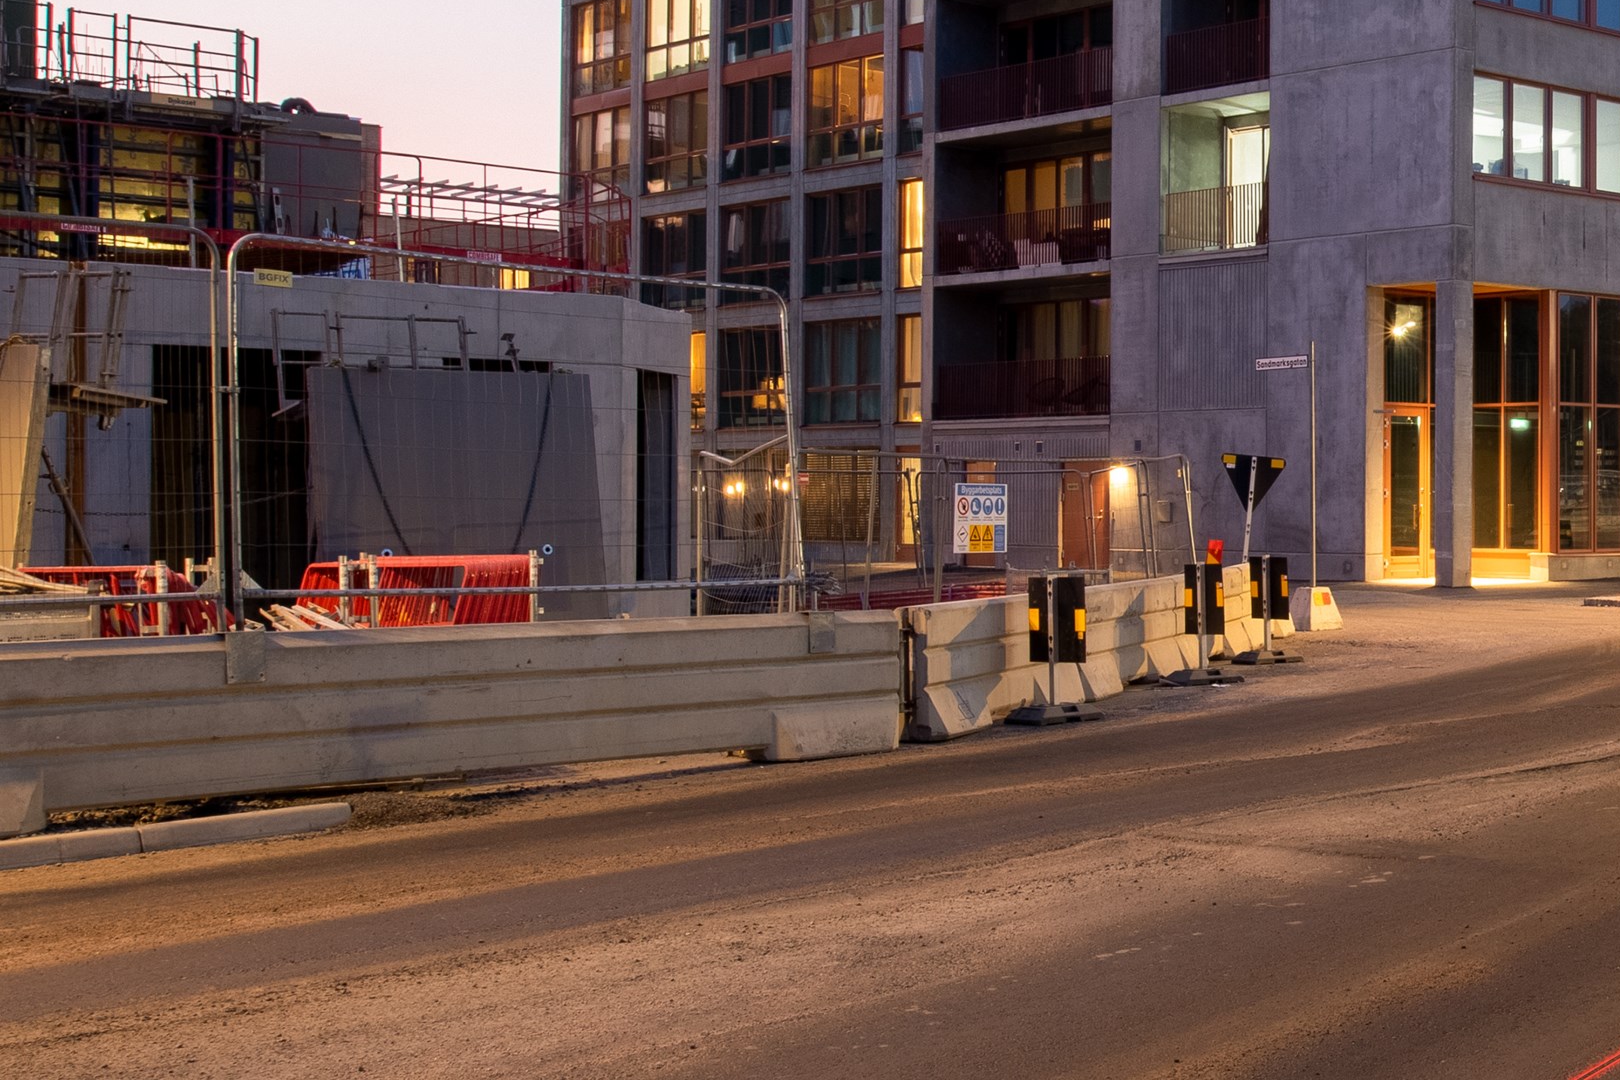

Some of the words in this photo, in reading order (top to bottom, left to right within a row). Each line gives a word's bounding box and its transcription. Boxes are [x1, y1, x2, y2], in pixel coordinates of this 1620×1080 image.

[258, 272, 289, 283] BGFIX
[1256, 358, 1307, 369] Sandmarksgatan
[961, 485, 1003, 496] Byggarbetsplats
